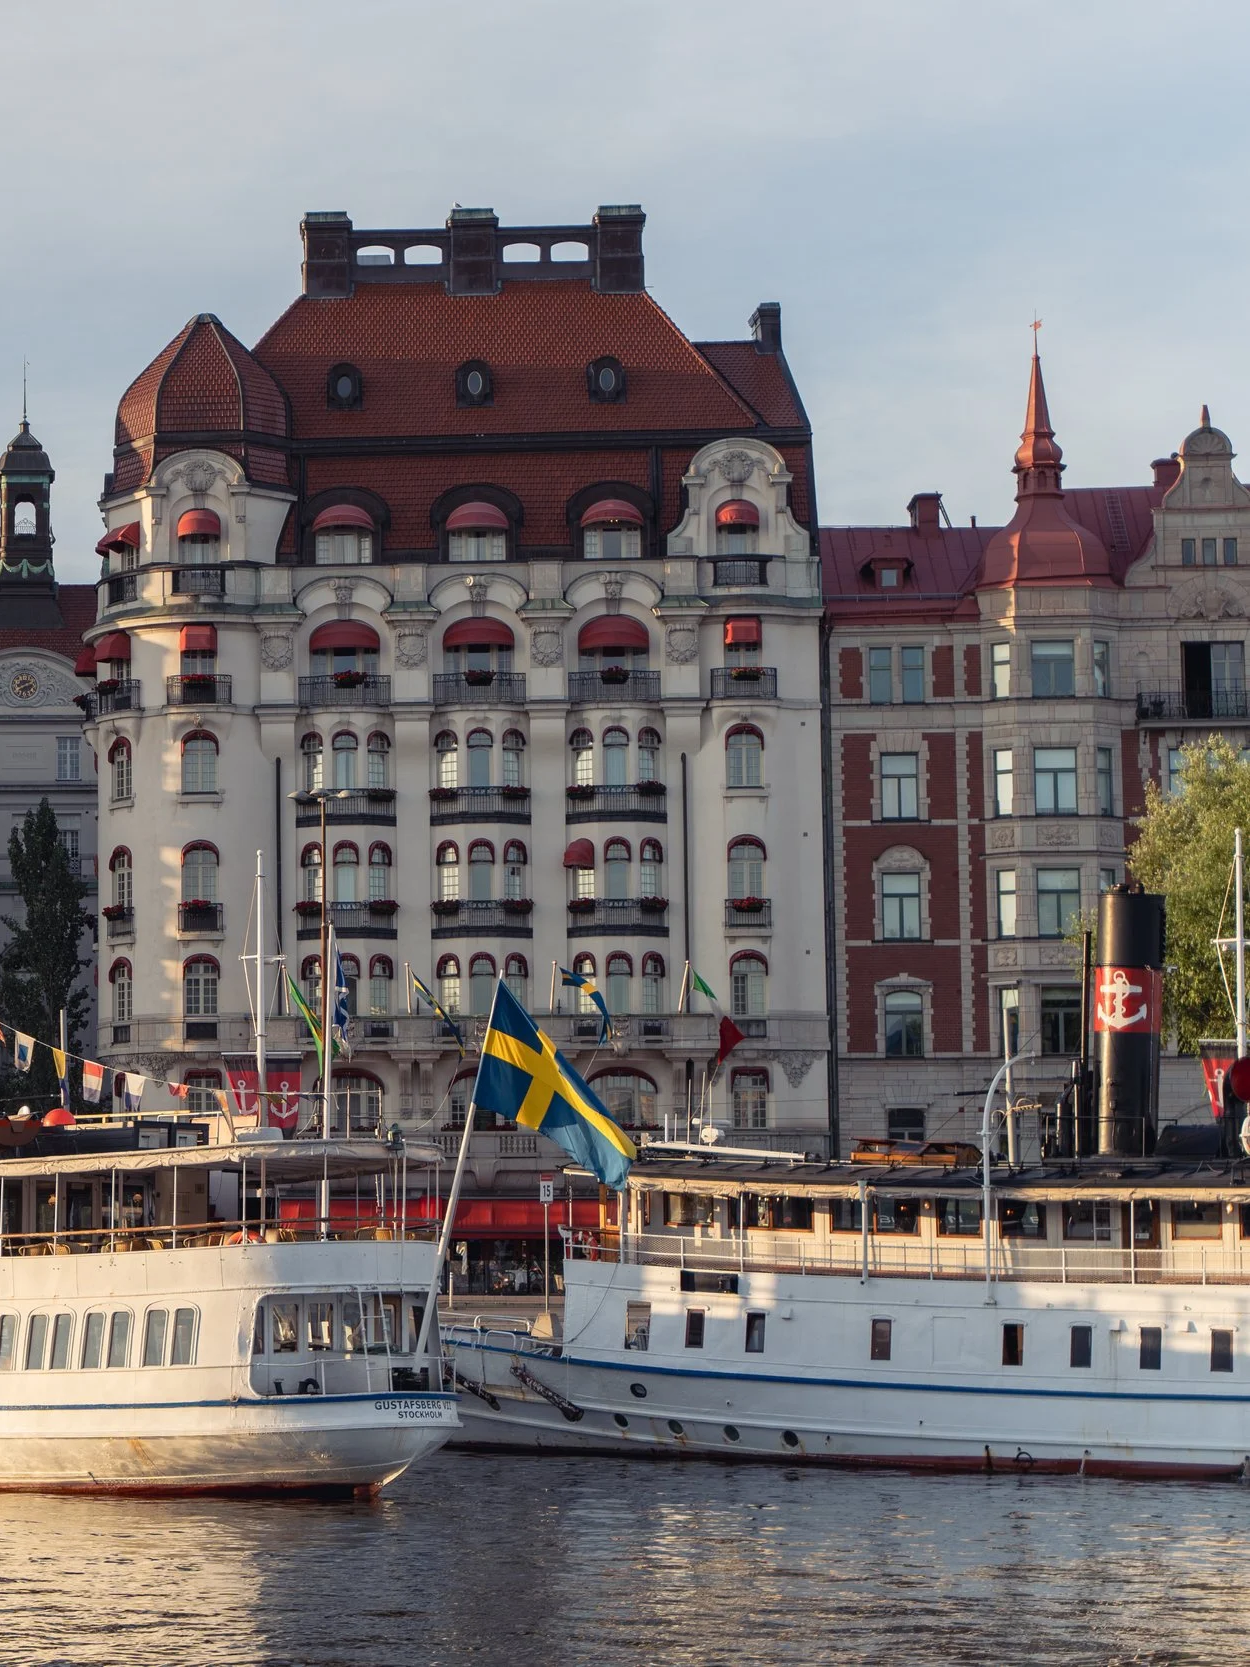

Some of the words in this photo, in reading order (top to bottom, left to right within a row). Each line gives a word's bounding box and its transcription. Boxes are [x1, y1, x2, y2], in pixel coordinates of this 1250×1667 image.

[543, 1185, 551, 1197] 15
[374, 1400, 441, 1410] GUSTAFSBERG
[398, 1410, 443, 1419] STOCKHOLM
